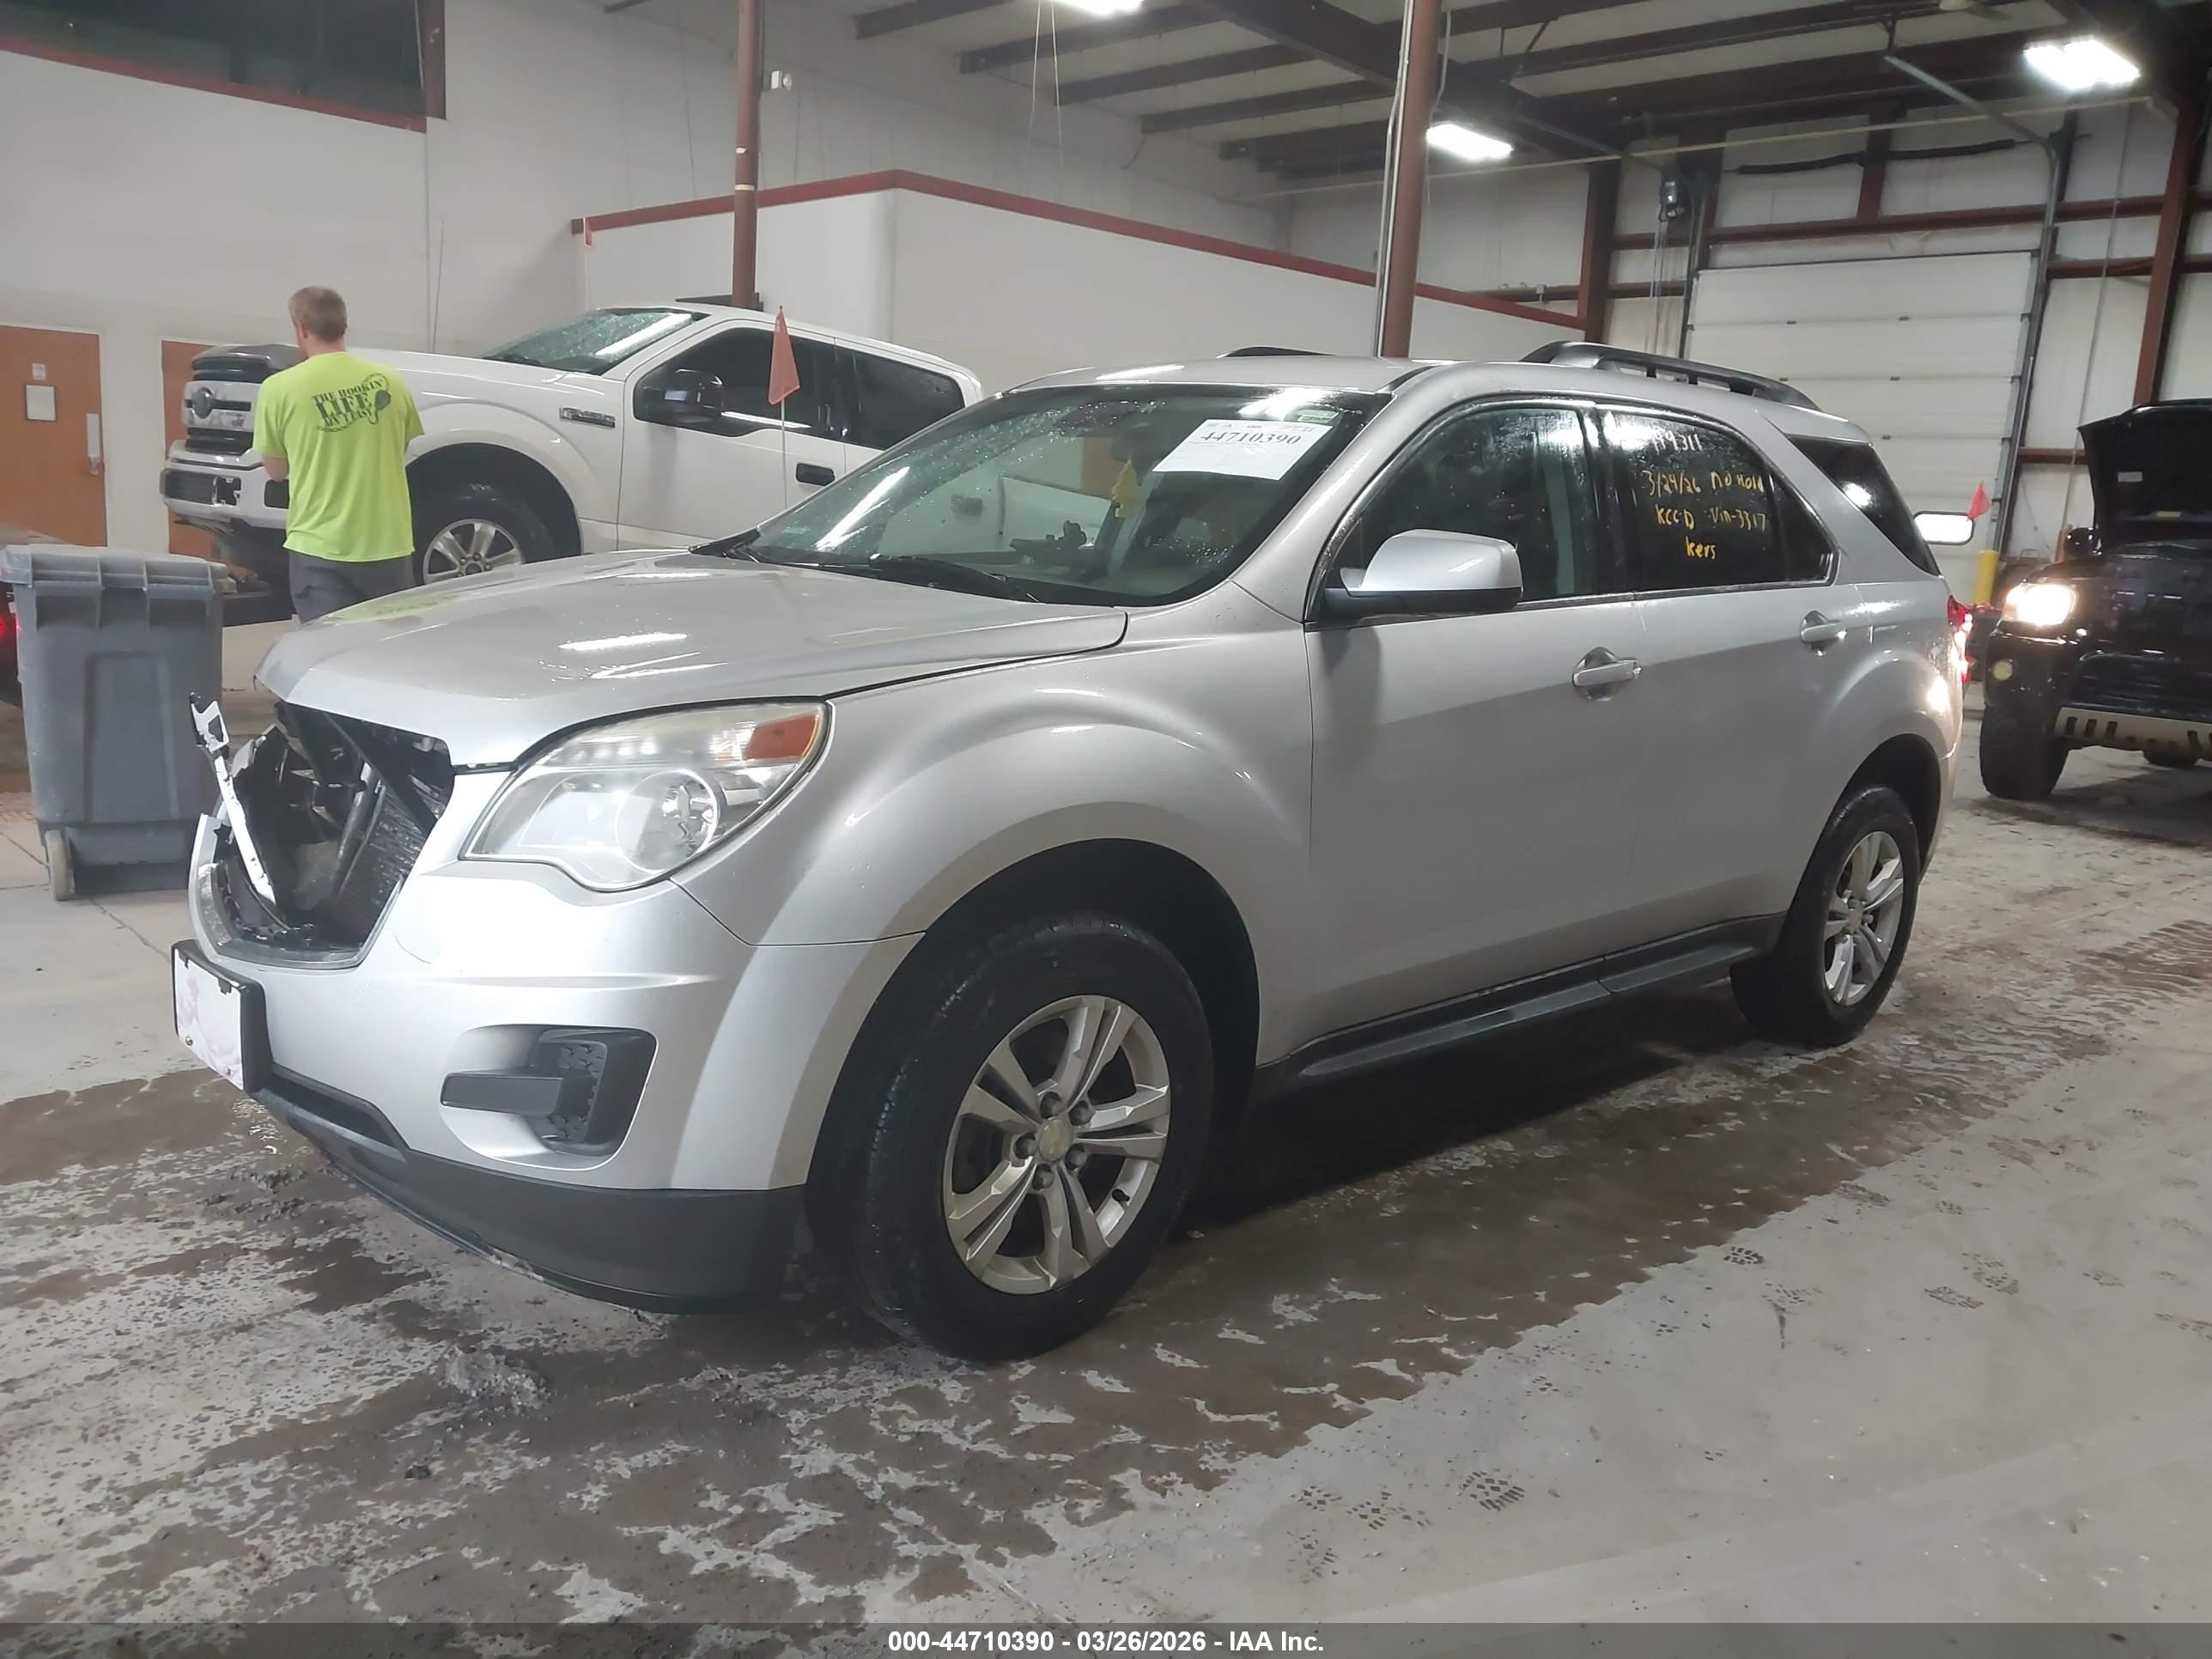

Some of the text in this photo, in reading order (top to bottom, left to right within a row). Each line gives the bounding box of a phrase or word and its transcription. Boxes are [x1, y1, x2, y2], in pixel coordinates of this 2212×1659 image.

[311, 392, 335, 404] THE
[315, 393, 372, 419] LIFE
[1200, 431, 1302, 445] 44710390
[1641, 470, 1702, 498] 3/24/26
